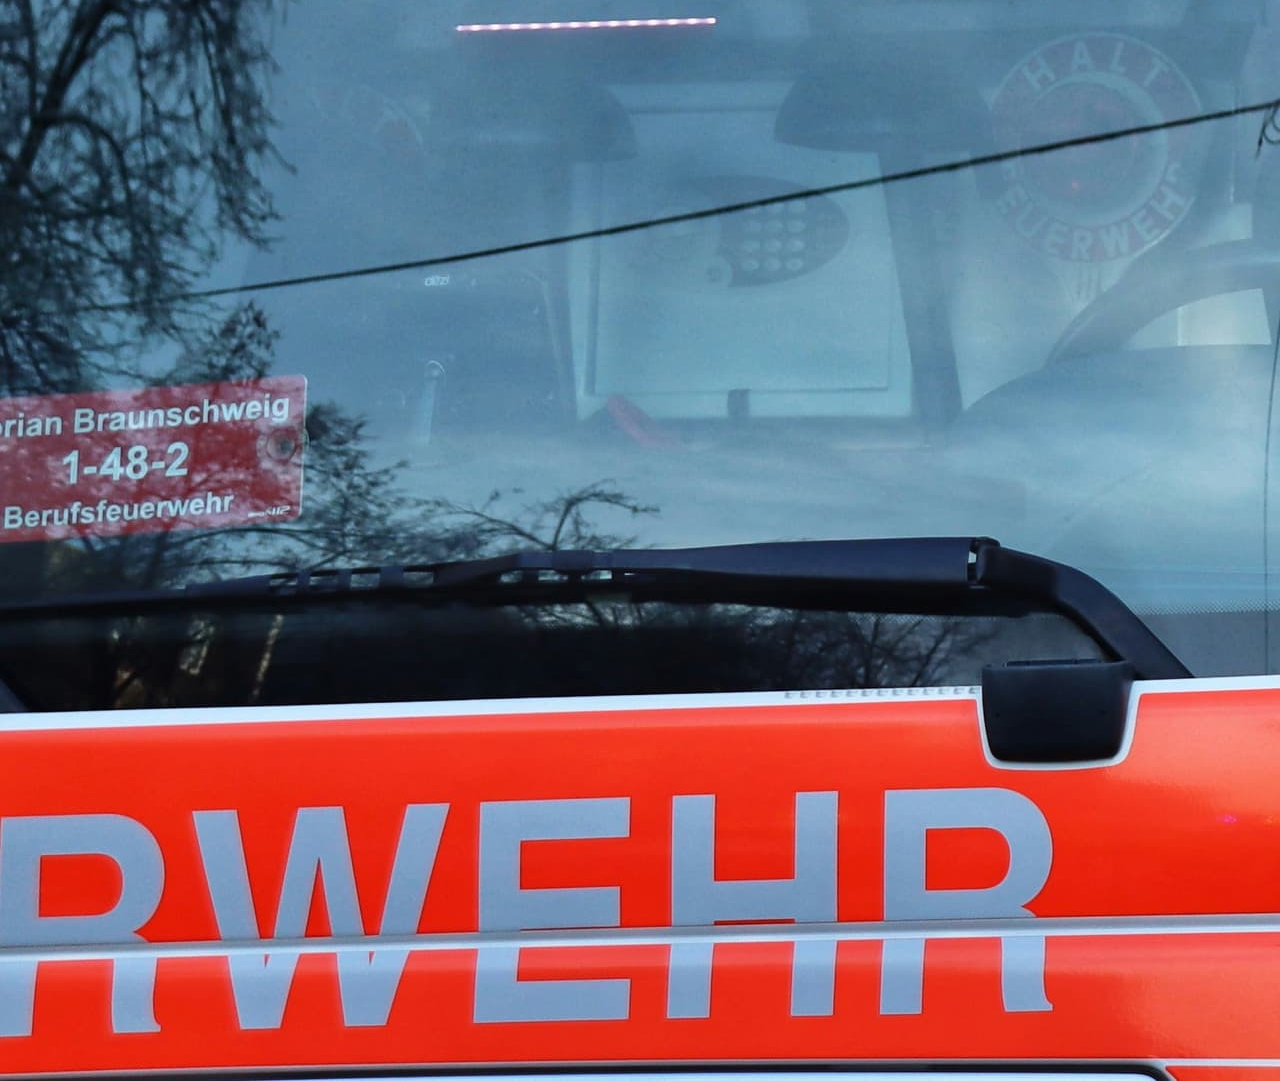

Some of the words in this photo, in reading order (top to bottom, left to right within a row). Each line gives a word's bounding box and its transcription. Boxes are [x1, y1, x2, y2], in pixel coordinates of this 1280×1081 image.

[1021, 40, 1170, 91] HALT
[0, 412, 63, 438] rian
[73, 393, 290, 434] Braunschweig
[62, 441, 189, 485] 1-48-2
[3, 491, 234, 530] Berufsfeuerwehr
[0, 785, 1054, 1037] RWEHR
